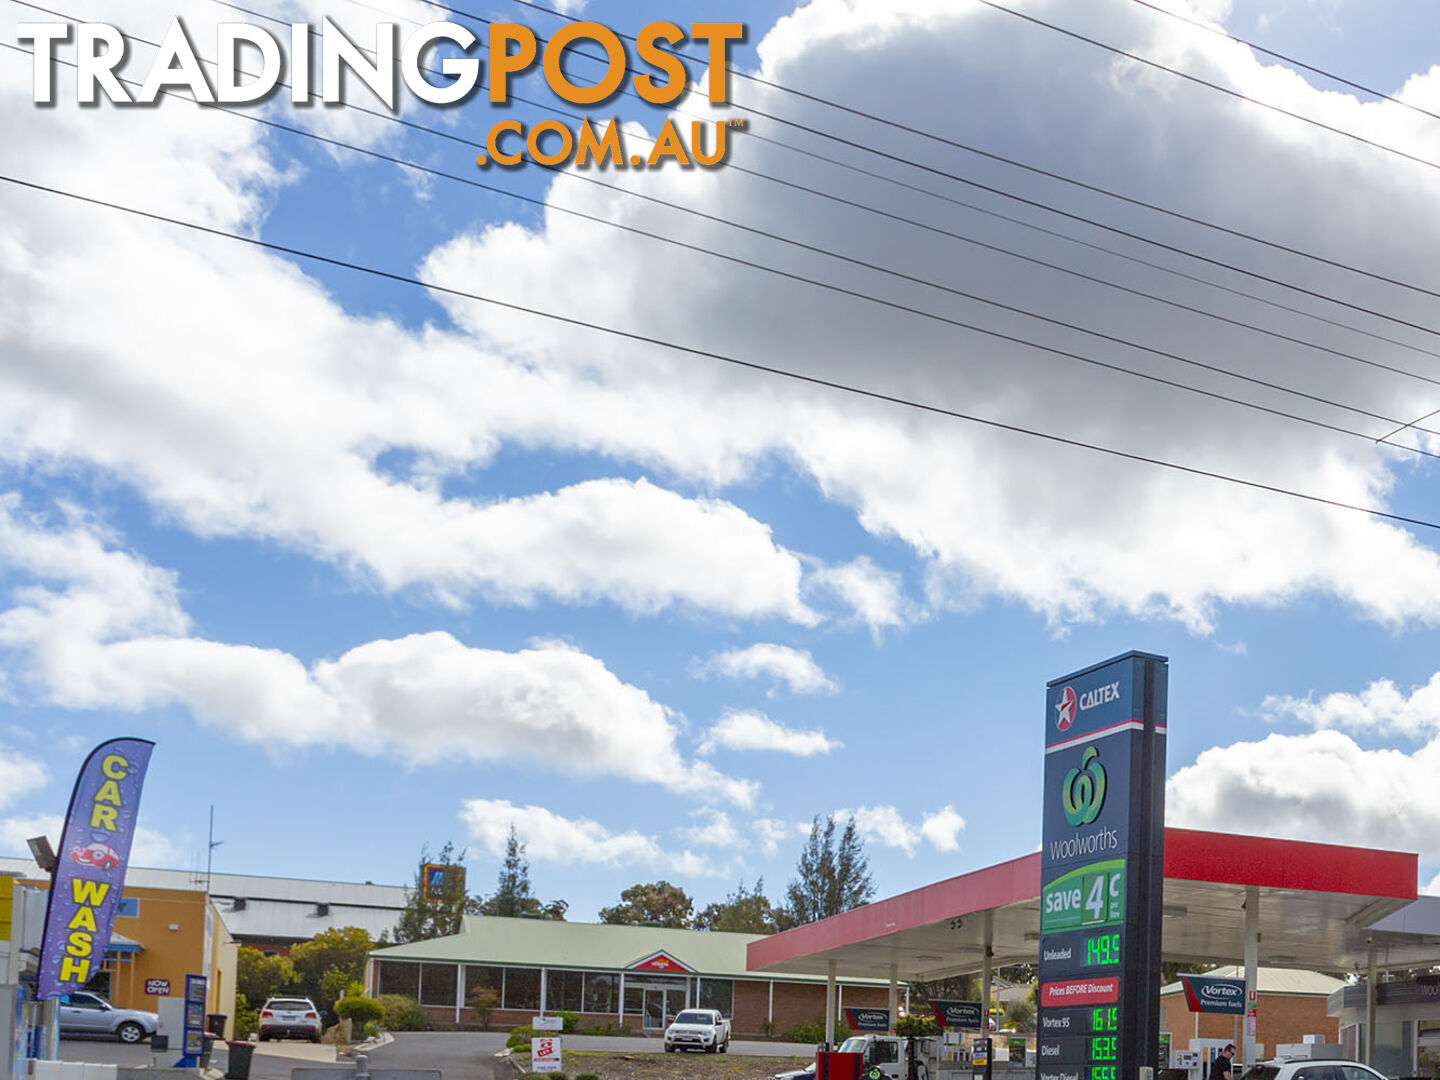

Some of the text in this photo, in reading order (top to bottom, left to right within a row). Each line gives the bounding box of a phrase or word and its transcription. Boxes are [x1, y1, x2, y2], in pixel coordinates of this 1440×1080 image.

[1079, 681, 1120, 710] CALTEX
[59, 755, 129, 983] CAR WASH
[1045, 888, 1081, 913] save
[1043, 948, 1072, 960] Unleaded
[147, 986, 169, 994] OPEN
[1049, 983, 1114, 996] Prices BEFORE Discount
[1205, 985, 1237, 996] Vortex
[1201, 999, 1242, 1008] Premium fuels
[949, 1007, 976, 1015] Vortex
[1042, 1016, 1061, 1028] Vortex
[1062, 1017, 1070, 1028] 95
[1041, 1044, 1060, 1056] Diesel
